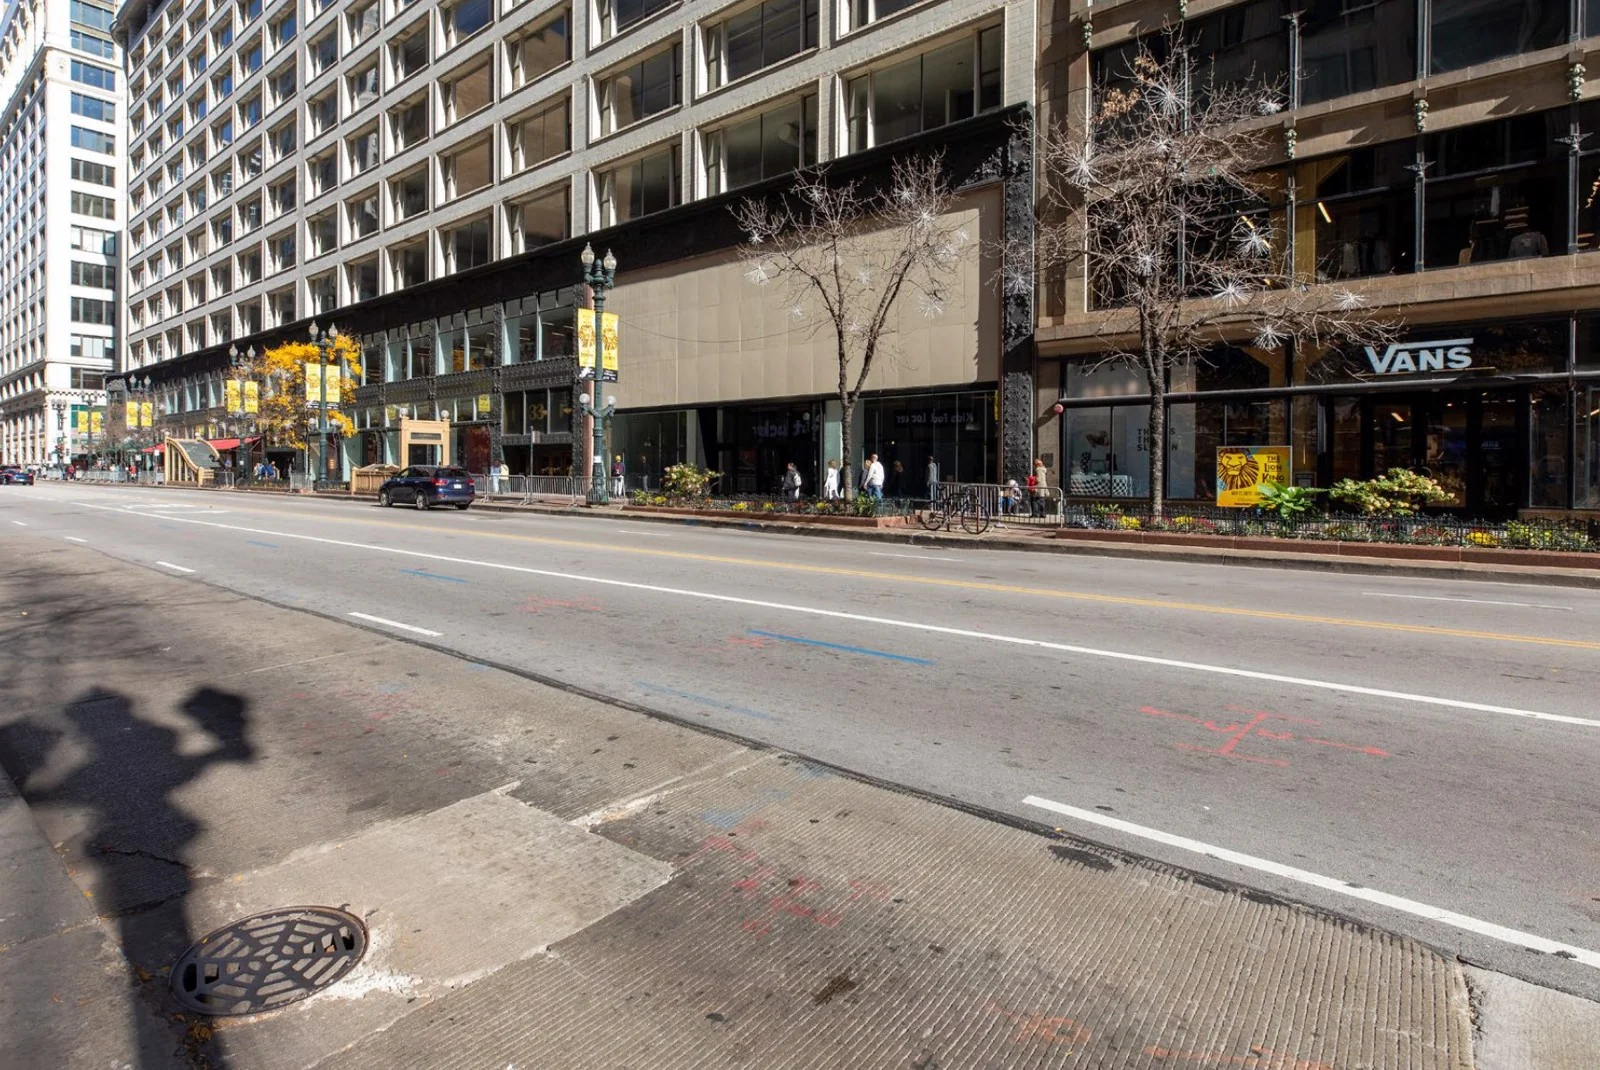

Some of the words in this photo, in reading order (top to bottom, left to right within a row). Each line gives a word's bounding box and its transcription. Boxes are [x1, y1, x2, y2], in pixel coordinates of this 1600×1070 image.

[1364, 338, 1474, 375] VANS
[1264, 462, 1282, 472] LION
[1262, 473, 1285, 483] KING
